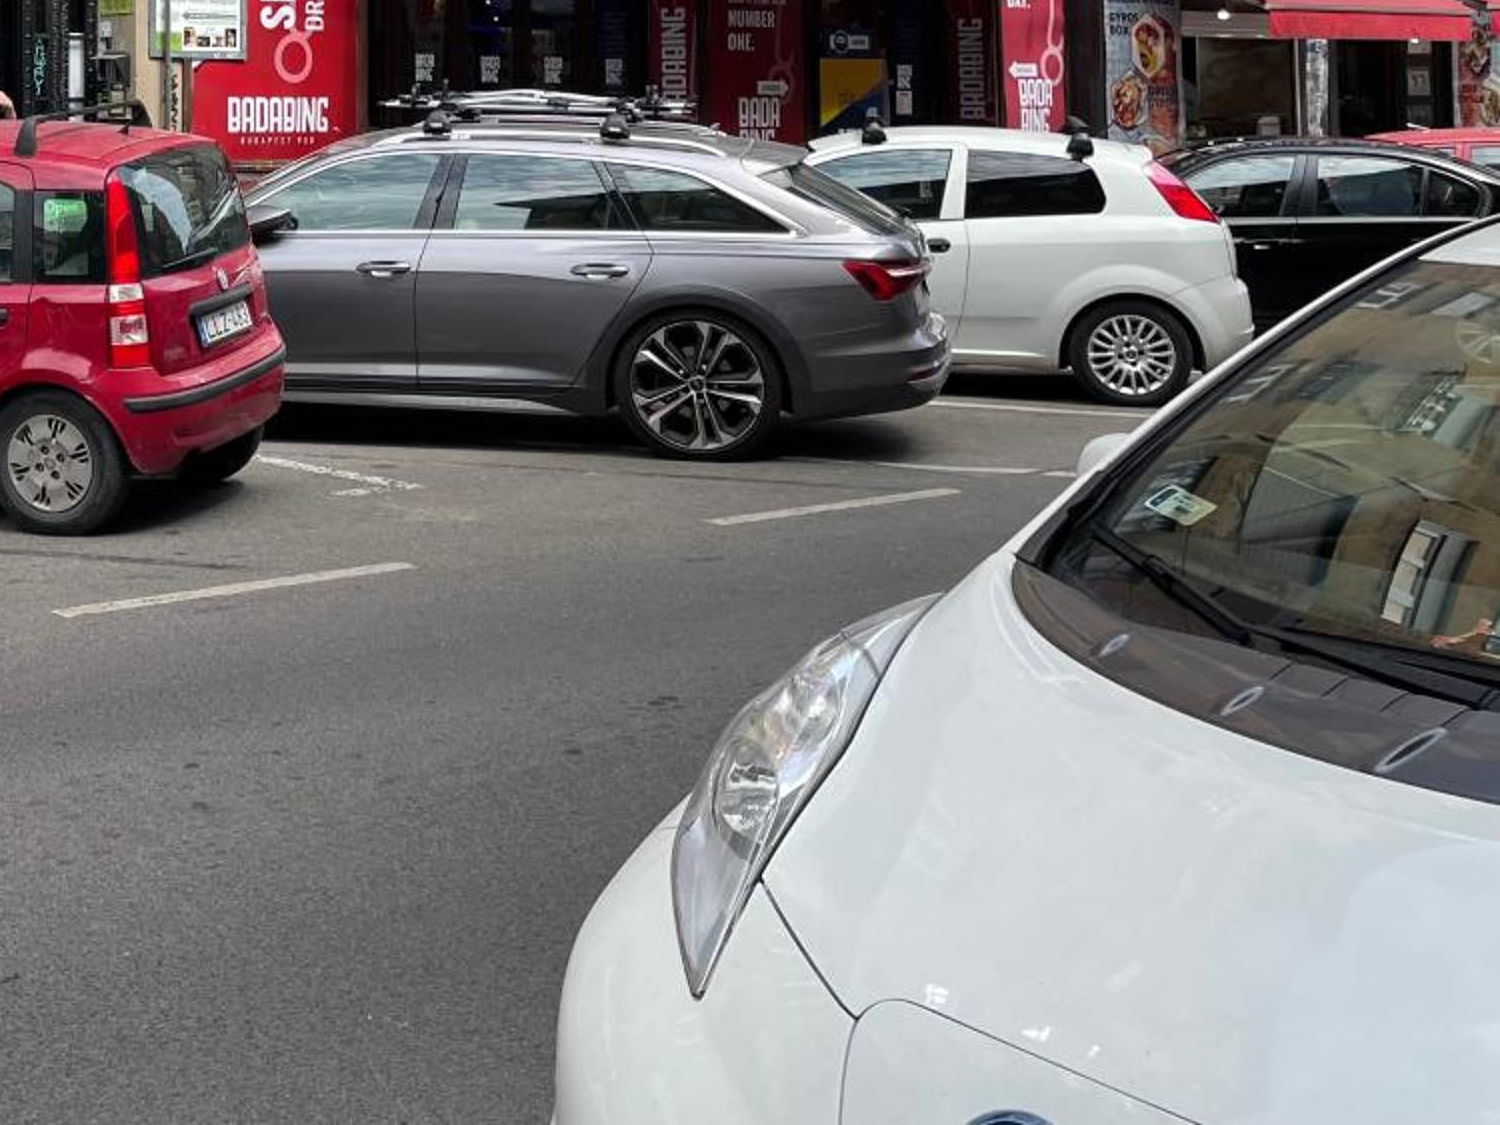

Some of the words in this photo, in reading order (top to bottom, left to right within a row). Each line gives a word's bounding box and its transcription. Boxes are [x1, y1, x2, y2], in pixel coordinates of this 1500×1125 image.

[728, 11, 775, 28] NUMBER
[728, 33, 755, 52] ONE.
[957, 17, 987, 120] BADABING
[1018, 79, 1053, 108] BADA
[228, 96, 329, 134] BADABING
[738, 97, 781, 128] BADA
